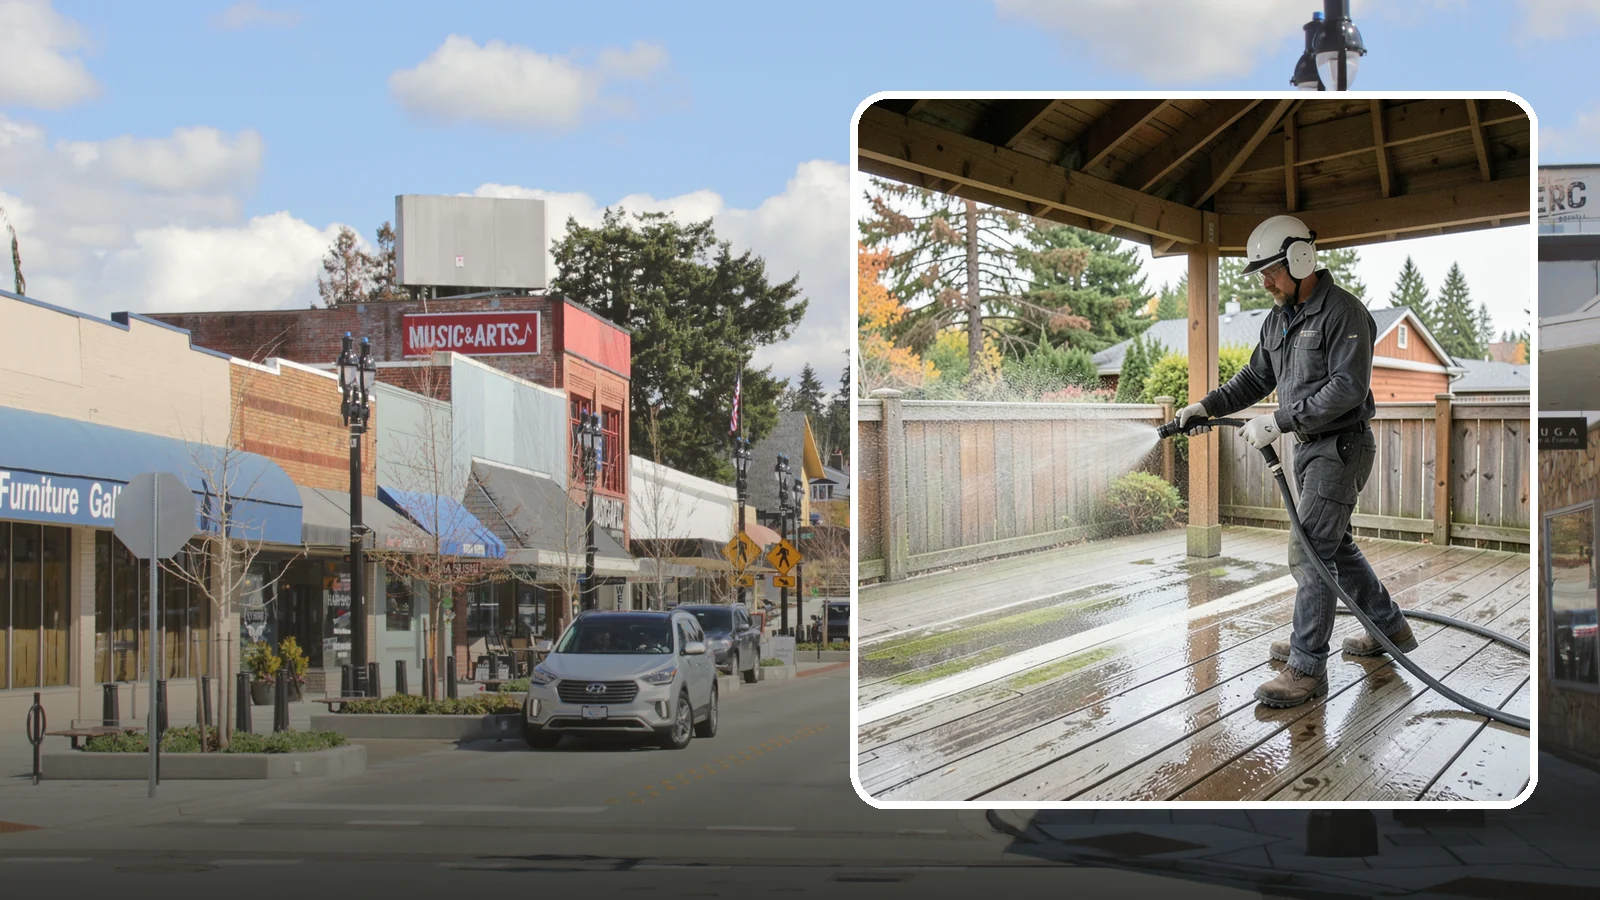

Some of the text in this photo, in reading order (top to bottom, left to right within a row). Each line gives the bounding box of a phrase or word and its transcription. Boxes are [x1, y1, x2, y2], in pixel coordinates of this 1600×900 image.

[0, 472, 122, 519] Furniture Gal
[453, 563, 479, 574] SUSHI
